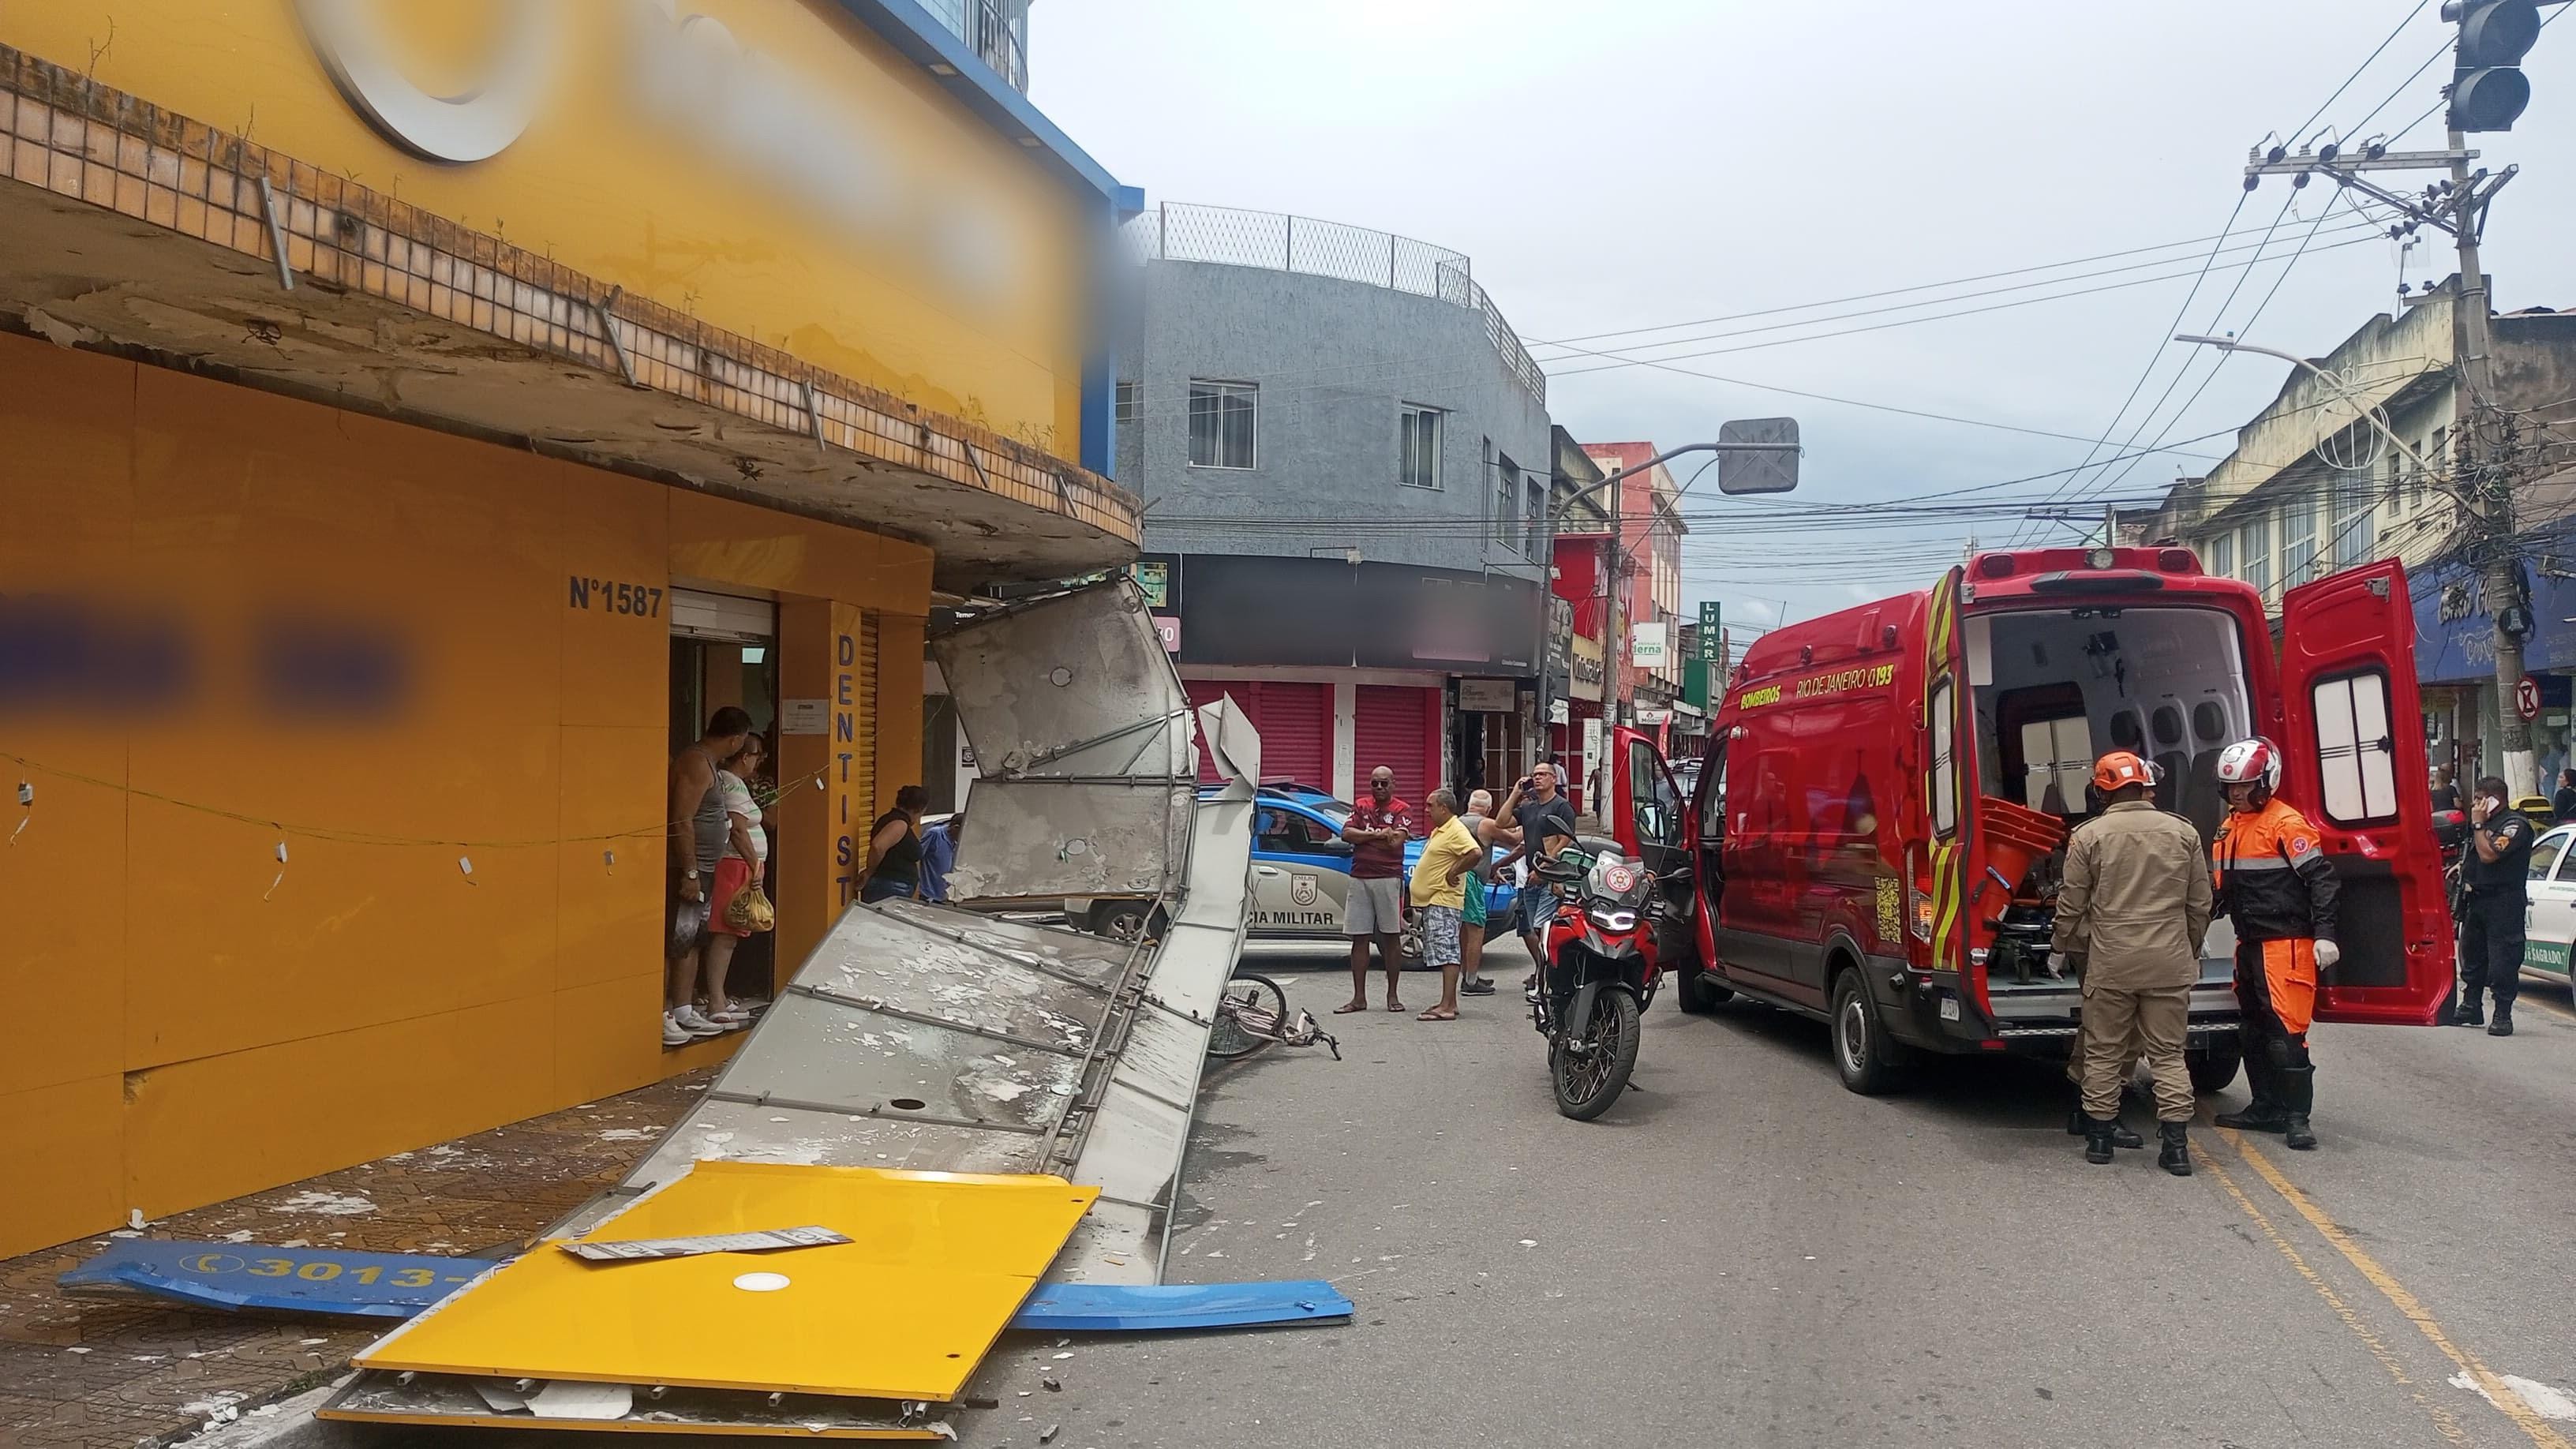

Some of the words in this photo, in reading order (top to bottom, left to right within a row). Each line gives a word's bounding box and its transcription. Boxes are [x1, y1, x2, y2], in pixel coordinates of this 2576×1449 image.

[1740, 684, 1781, 710] BOMBEIROS
[1796, 679, 1811, 699] RIO
[1811, 676, 1827, 696] DE
[1825, 668, 1866, 695] JANEIRO
[1875, 664, 1895, 687] 193
[837, 635, 855, 908] DENTIST
[1273, 911, 1334, 925] MILITAR
